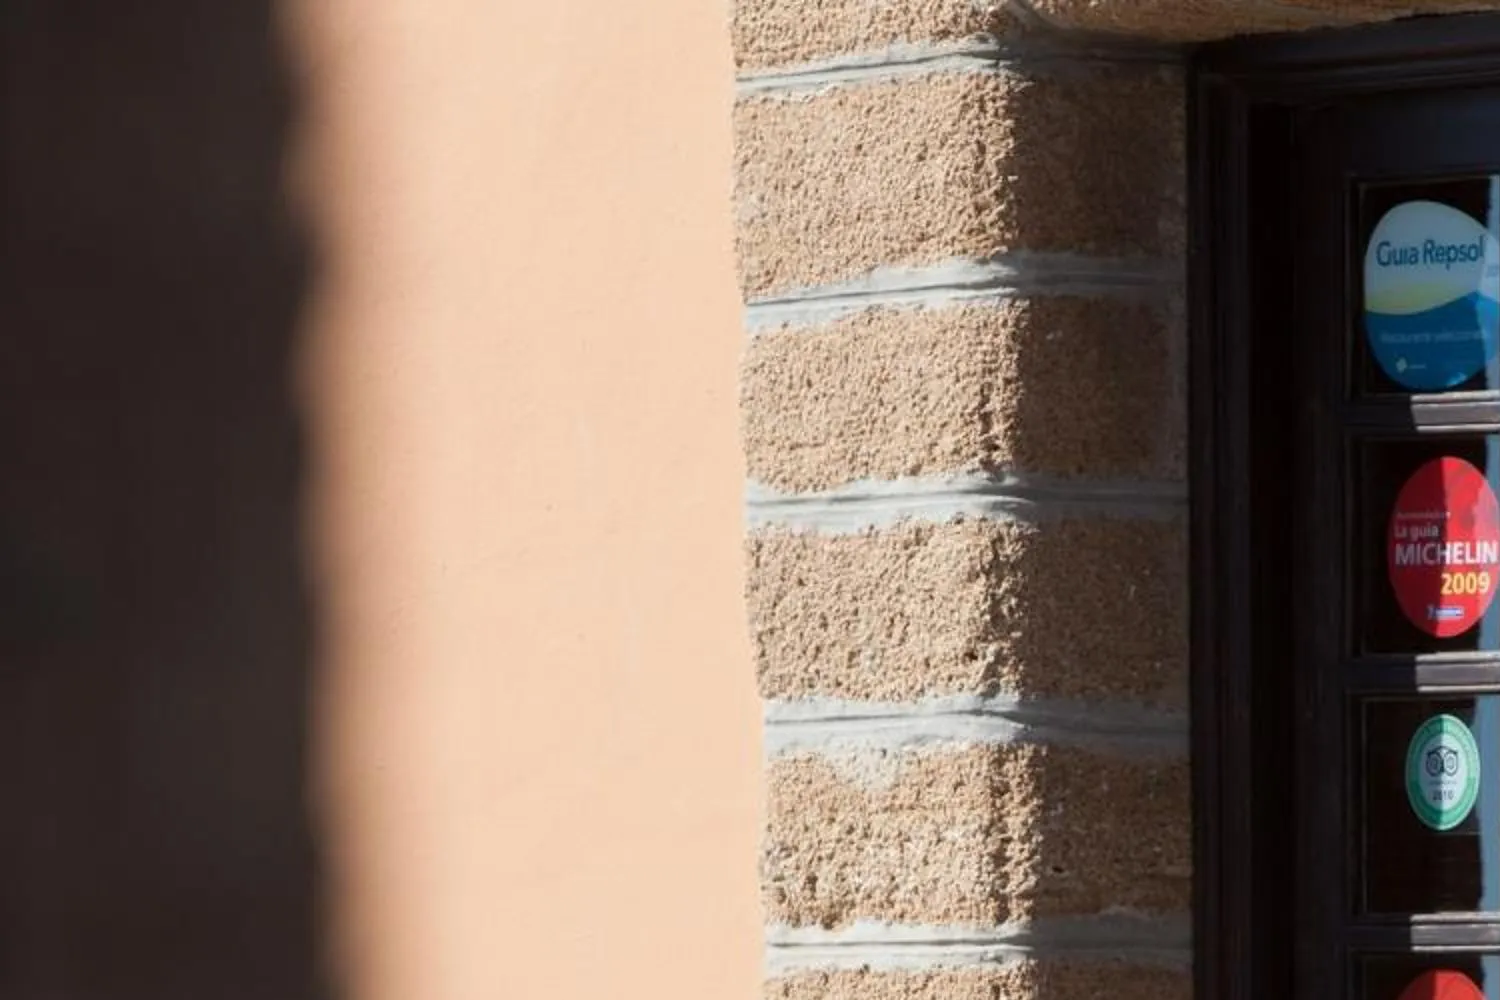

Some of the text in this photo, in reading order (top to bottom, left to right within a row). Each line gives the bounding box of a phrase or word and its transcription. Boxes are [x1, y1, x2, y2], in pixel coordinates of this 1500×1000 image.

[1423, 234, 1485, 270] Repsol
[1395, 540, 1499, 565] MICHELIN
[1441, 572, 1490, 595] 2009
